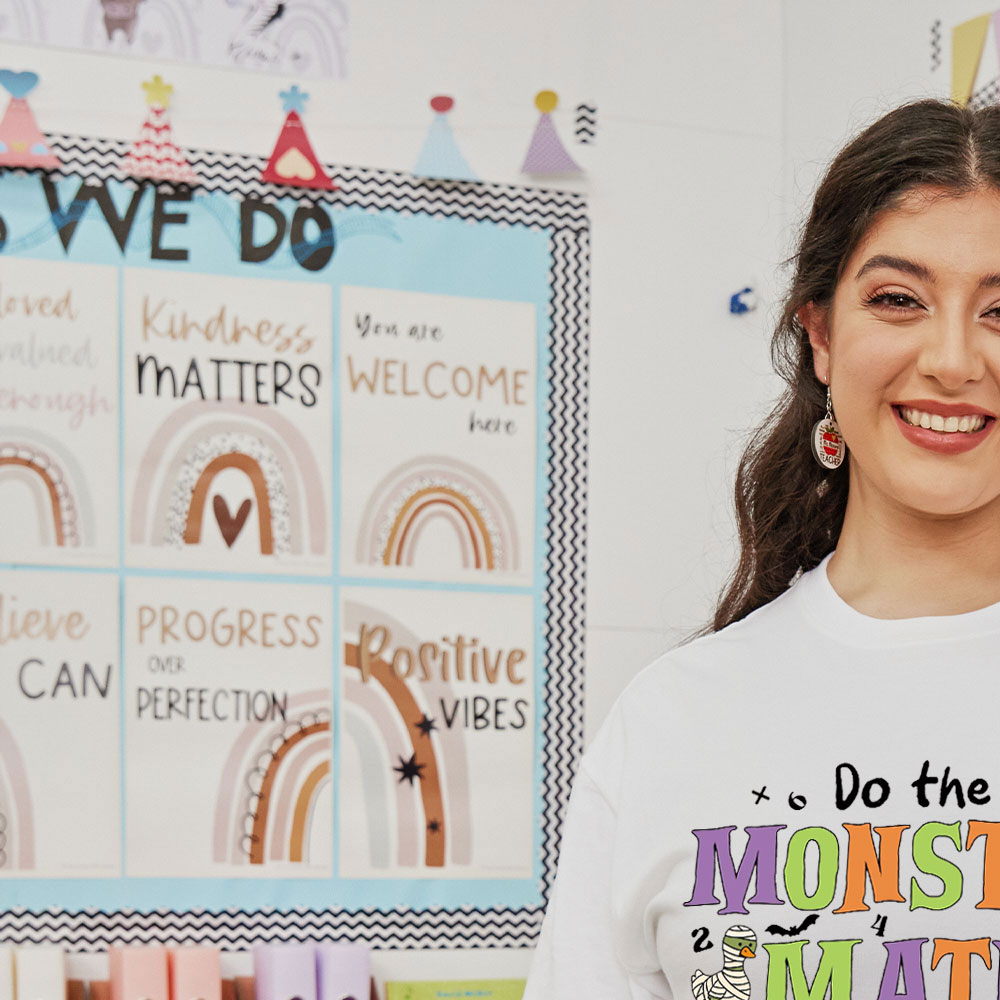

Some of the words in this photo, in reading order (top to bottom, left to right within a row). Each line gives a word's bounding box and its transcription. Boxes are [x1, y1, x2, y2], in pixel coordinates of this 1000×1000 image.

[41, 174, 193, 262] WE
[240, 194, 335, 272] DO
[142, 295, 317, 354] Kindness
[347, 354, 530, 406] WELCOME
[468, 411, 518, 435] here
[137, 604, 323, 648] PROGRESS
[149, 656, 185, 675] OVER
[359, 623, 527, 684] Positive
[19, 657, 112, 699] CAN
[137, 686, 289, 723] PERFECTION
[439, 696, 529, 731] VIBES
[835, 762, 891, 811] Do
[911, 760, 991, 809] the
